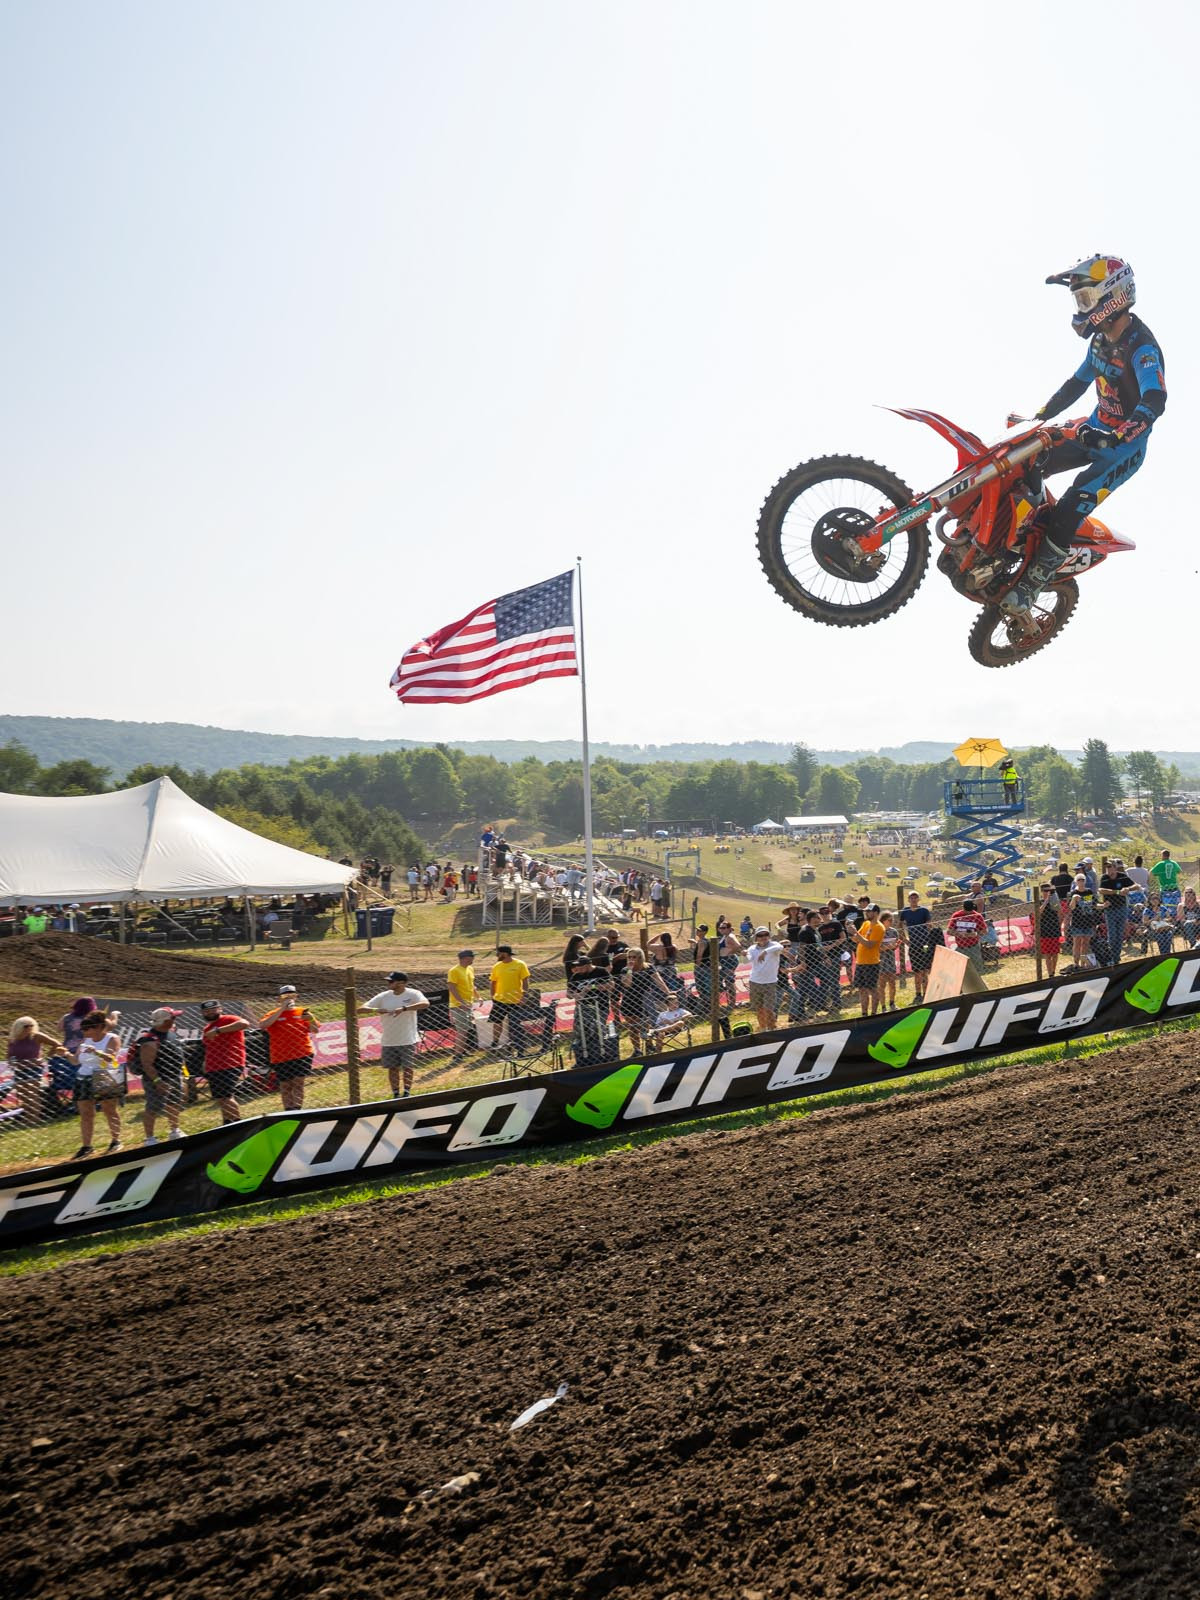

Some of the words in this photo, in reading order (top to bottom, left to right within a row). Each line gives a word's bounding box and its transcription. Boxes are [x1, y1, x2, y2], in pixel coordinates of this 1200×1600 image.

[1088, 303, 1111, 326] Red
[1109, 290, 1128, 312] Bull
[895, 506, 928, 529] MOTOREX
[916, 977, 1110, 1060] UFO
[1042, 1016, 1092, 1031] PLAST
[623, 1030, 851, 1120] UFO
[771, 1071, 829, 1087] PLAST
[273, 1087, 547, 1182] UFO
[454, 1133, 521, 1149] PLAST
[62, 1199, 147, 1220] PLAST
